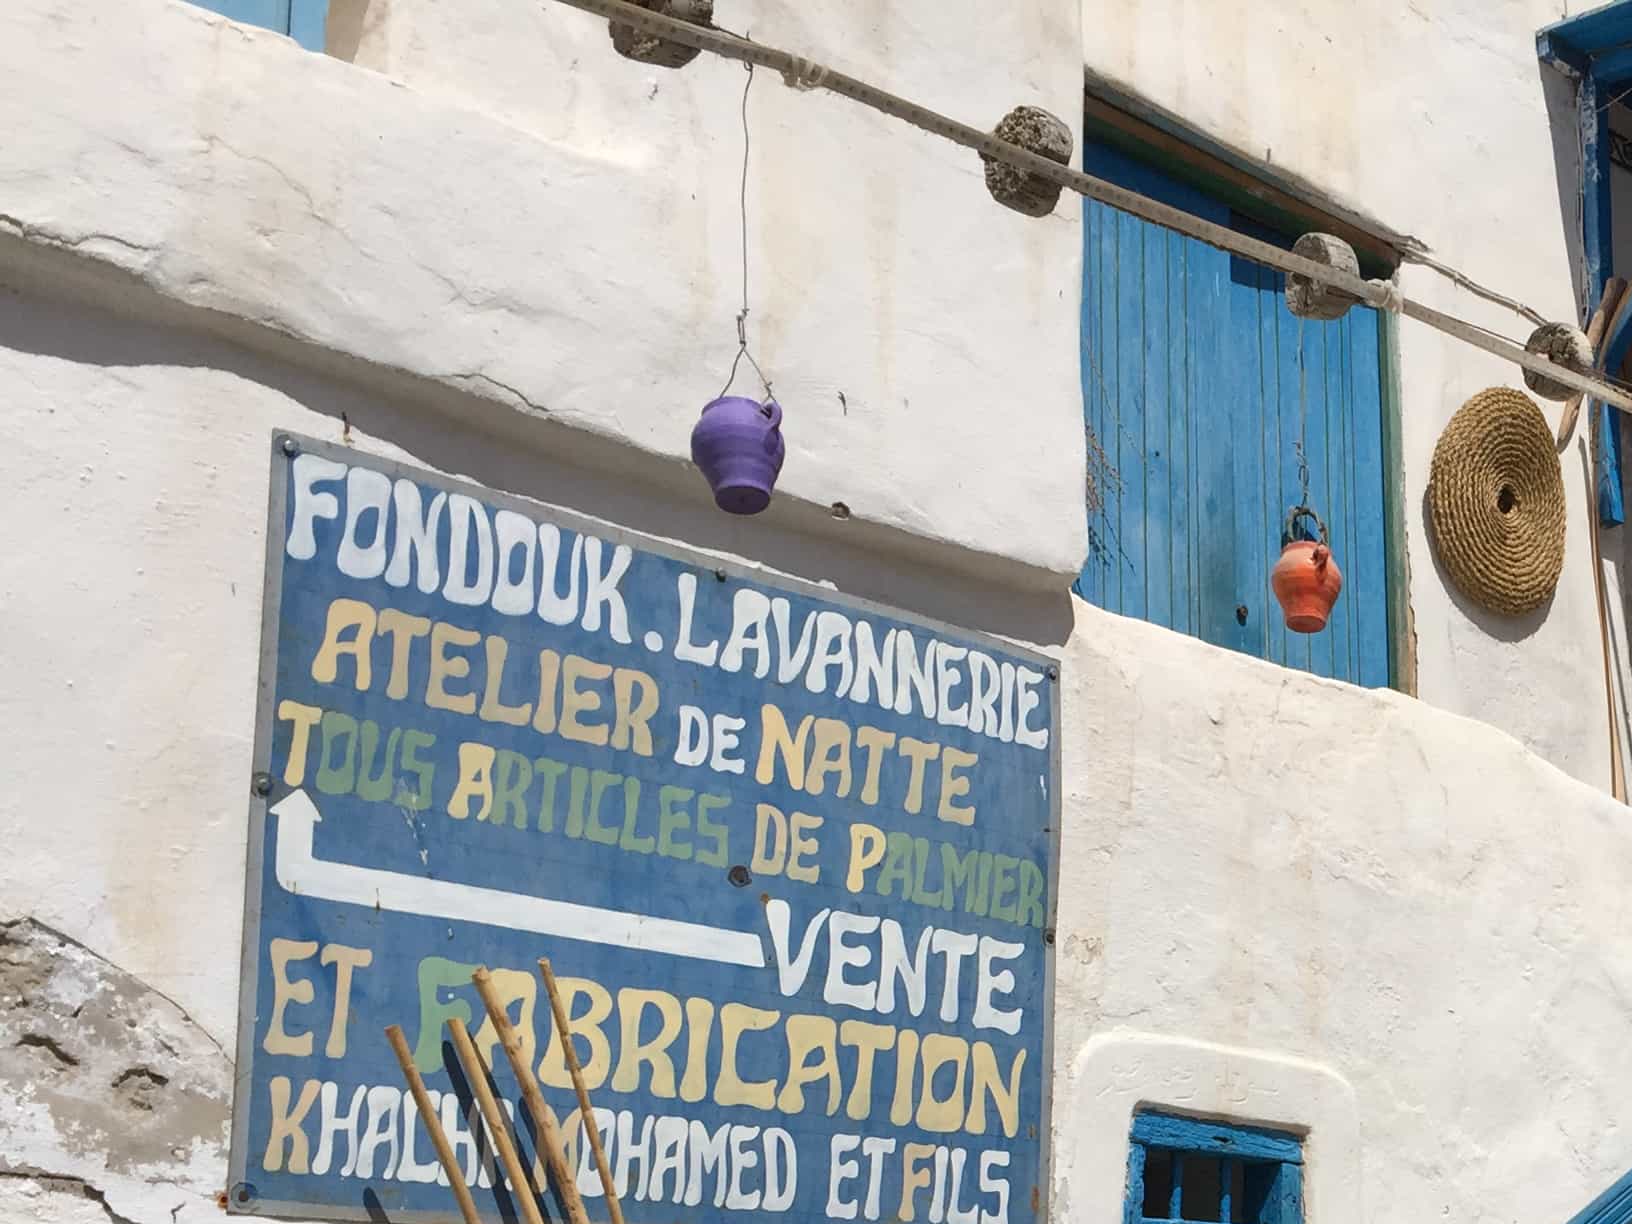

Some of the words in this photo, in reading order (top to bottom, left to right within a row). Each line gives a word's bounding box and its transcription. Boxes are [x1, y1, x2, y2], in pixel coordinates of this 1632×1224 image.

[311, 598, 660, 756] ATELIER
[674, 705, 745, 774] DE
[755, 704, 978, 826] NATTE
[278, 700, 436, 810] TOUS
[447, 742, 731, 868] ARTICLES
[751, 803, 824, 884] DE
[846, 823, 1044, 928] PALMIER
[263, 938, 373, 1058] ET
[410, 956, 1027, 1138] FABRICATION
[766, 899, 1024, 1035] VENTE
[826, 1134, 896, 1221] ET
